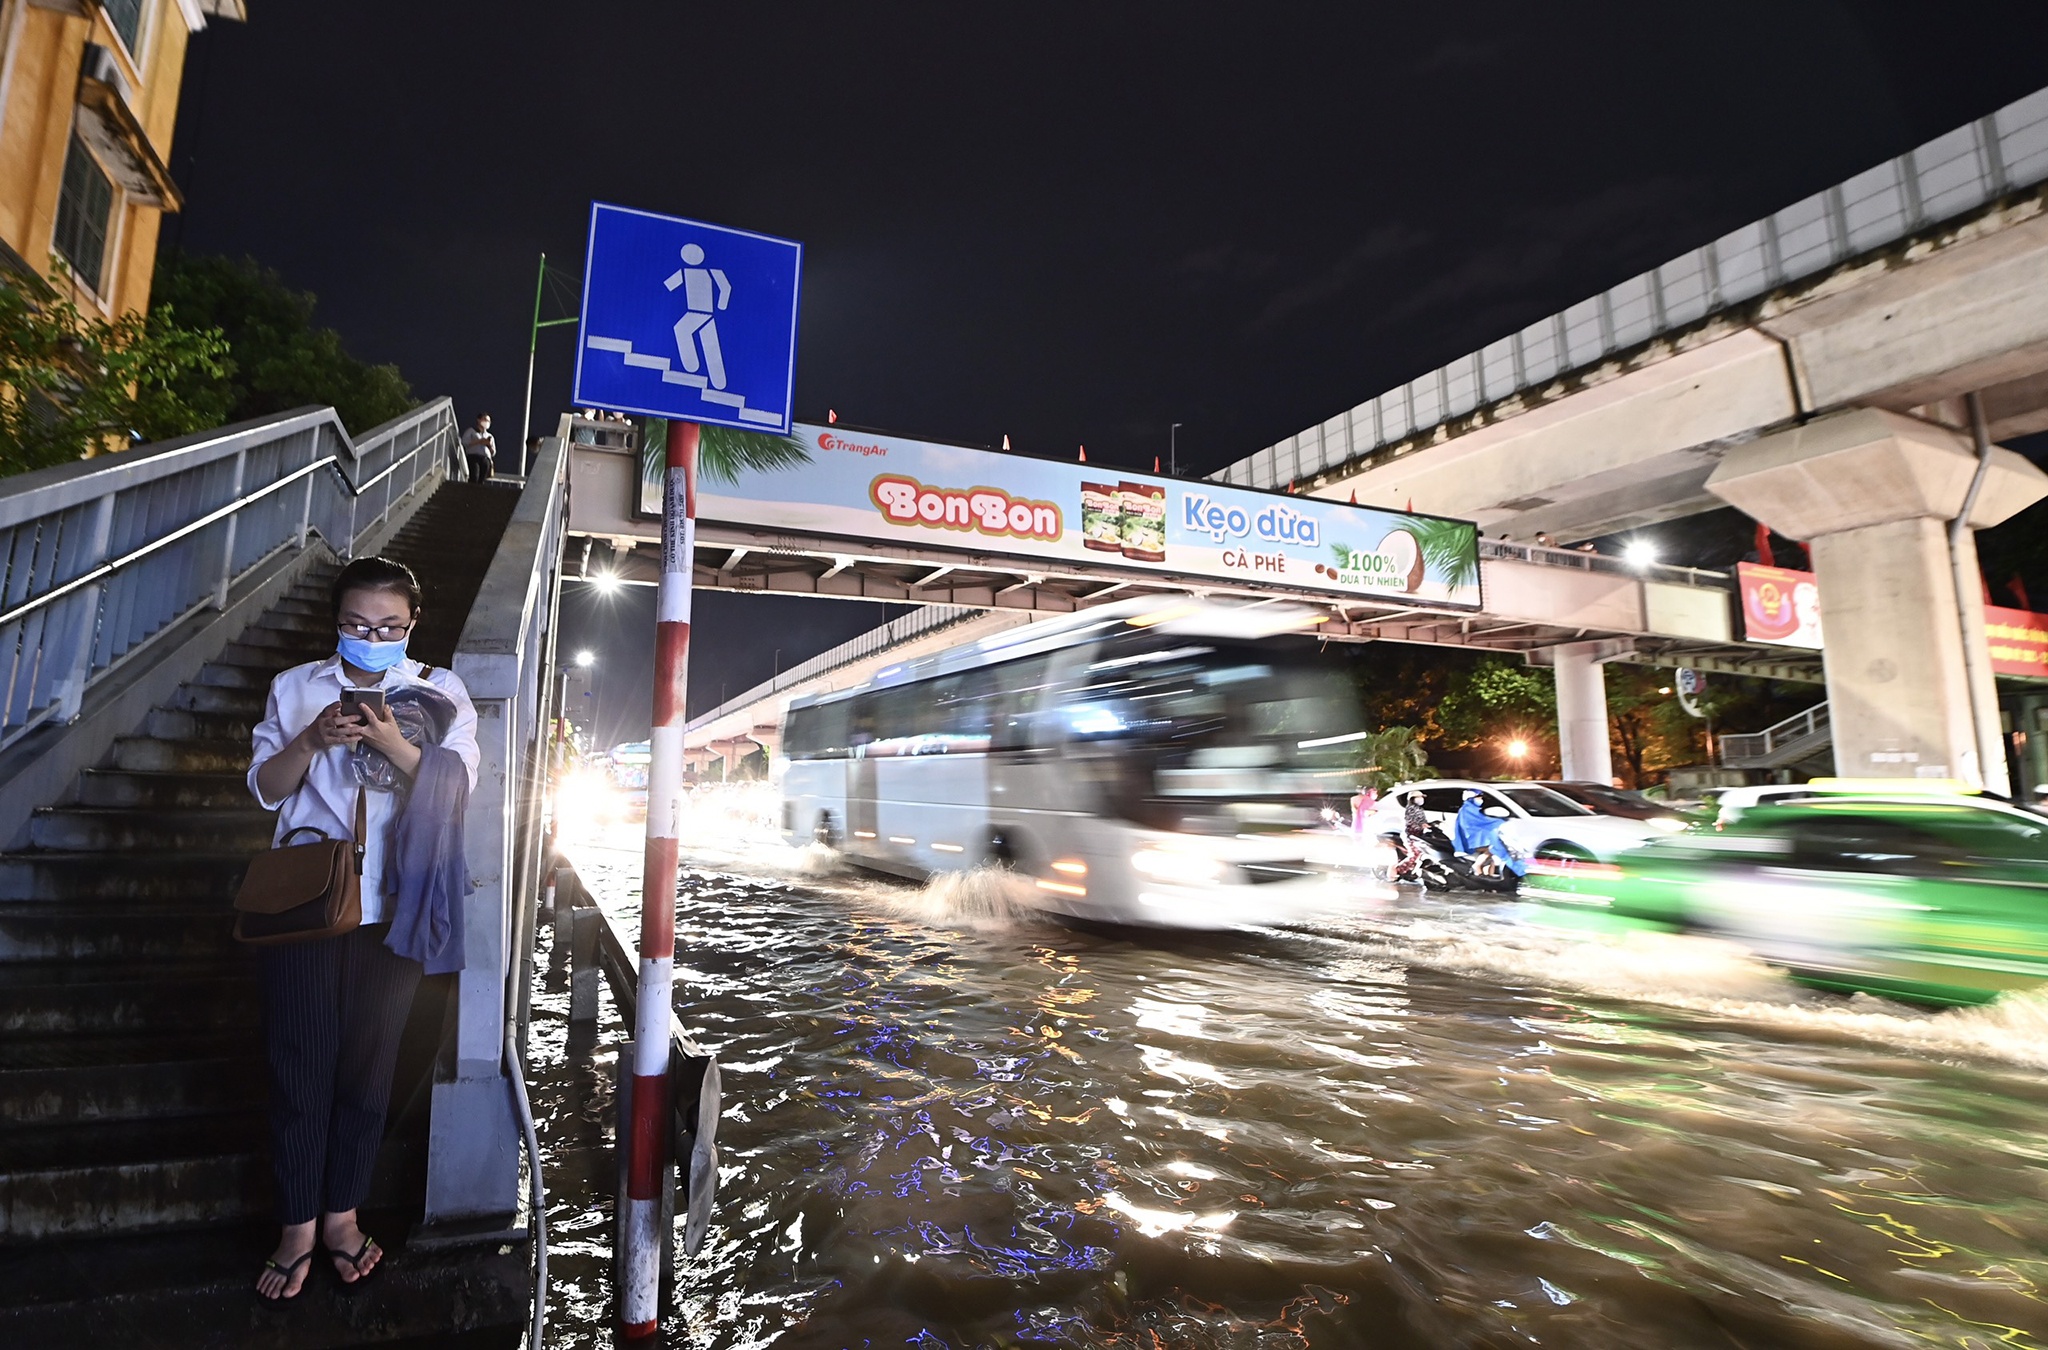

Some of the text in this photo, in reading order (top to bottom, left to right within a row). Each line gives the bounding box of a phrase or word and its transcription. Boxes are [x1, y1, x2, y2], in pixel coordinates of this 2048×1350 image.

[876, 481, 1057, 536] BonBon
[1185, 496, 1316, 543] Kẹo dừa
[1222, 547, 1286, 574] CÀ PHÊ
[1350, 552, 1396, 574] 100%
